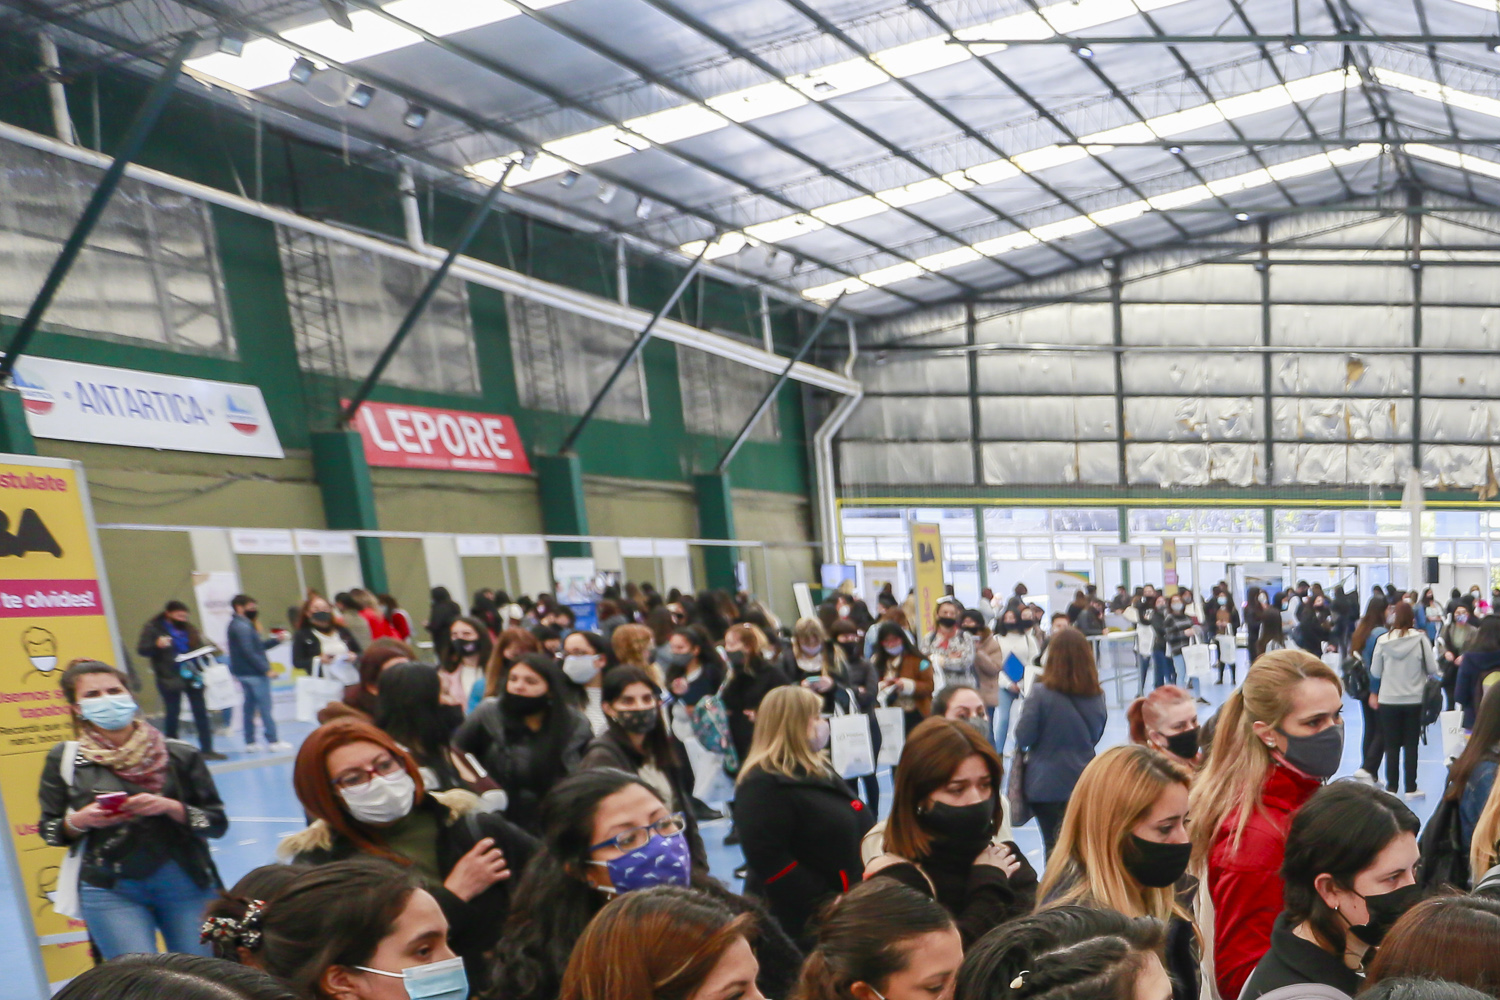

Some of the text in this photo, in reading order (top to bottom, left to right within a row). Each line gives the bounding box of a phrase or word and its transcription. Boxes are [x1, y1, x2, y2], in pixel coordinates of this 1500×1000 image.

[74, 380, 209, 426] ANTARTICA
[360, 405, 514, 460] LEPORE
[24, 589, 97, 609] olvides!
